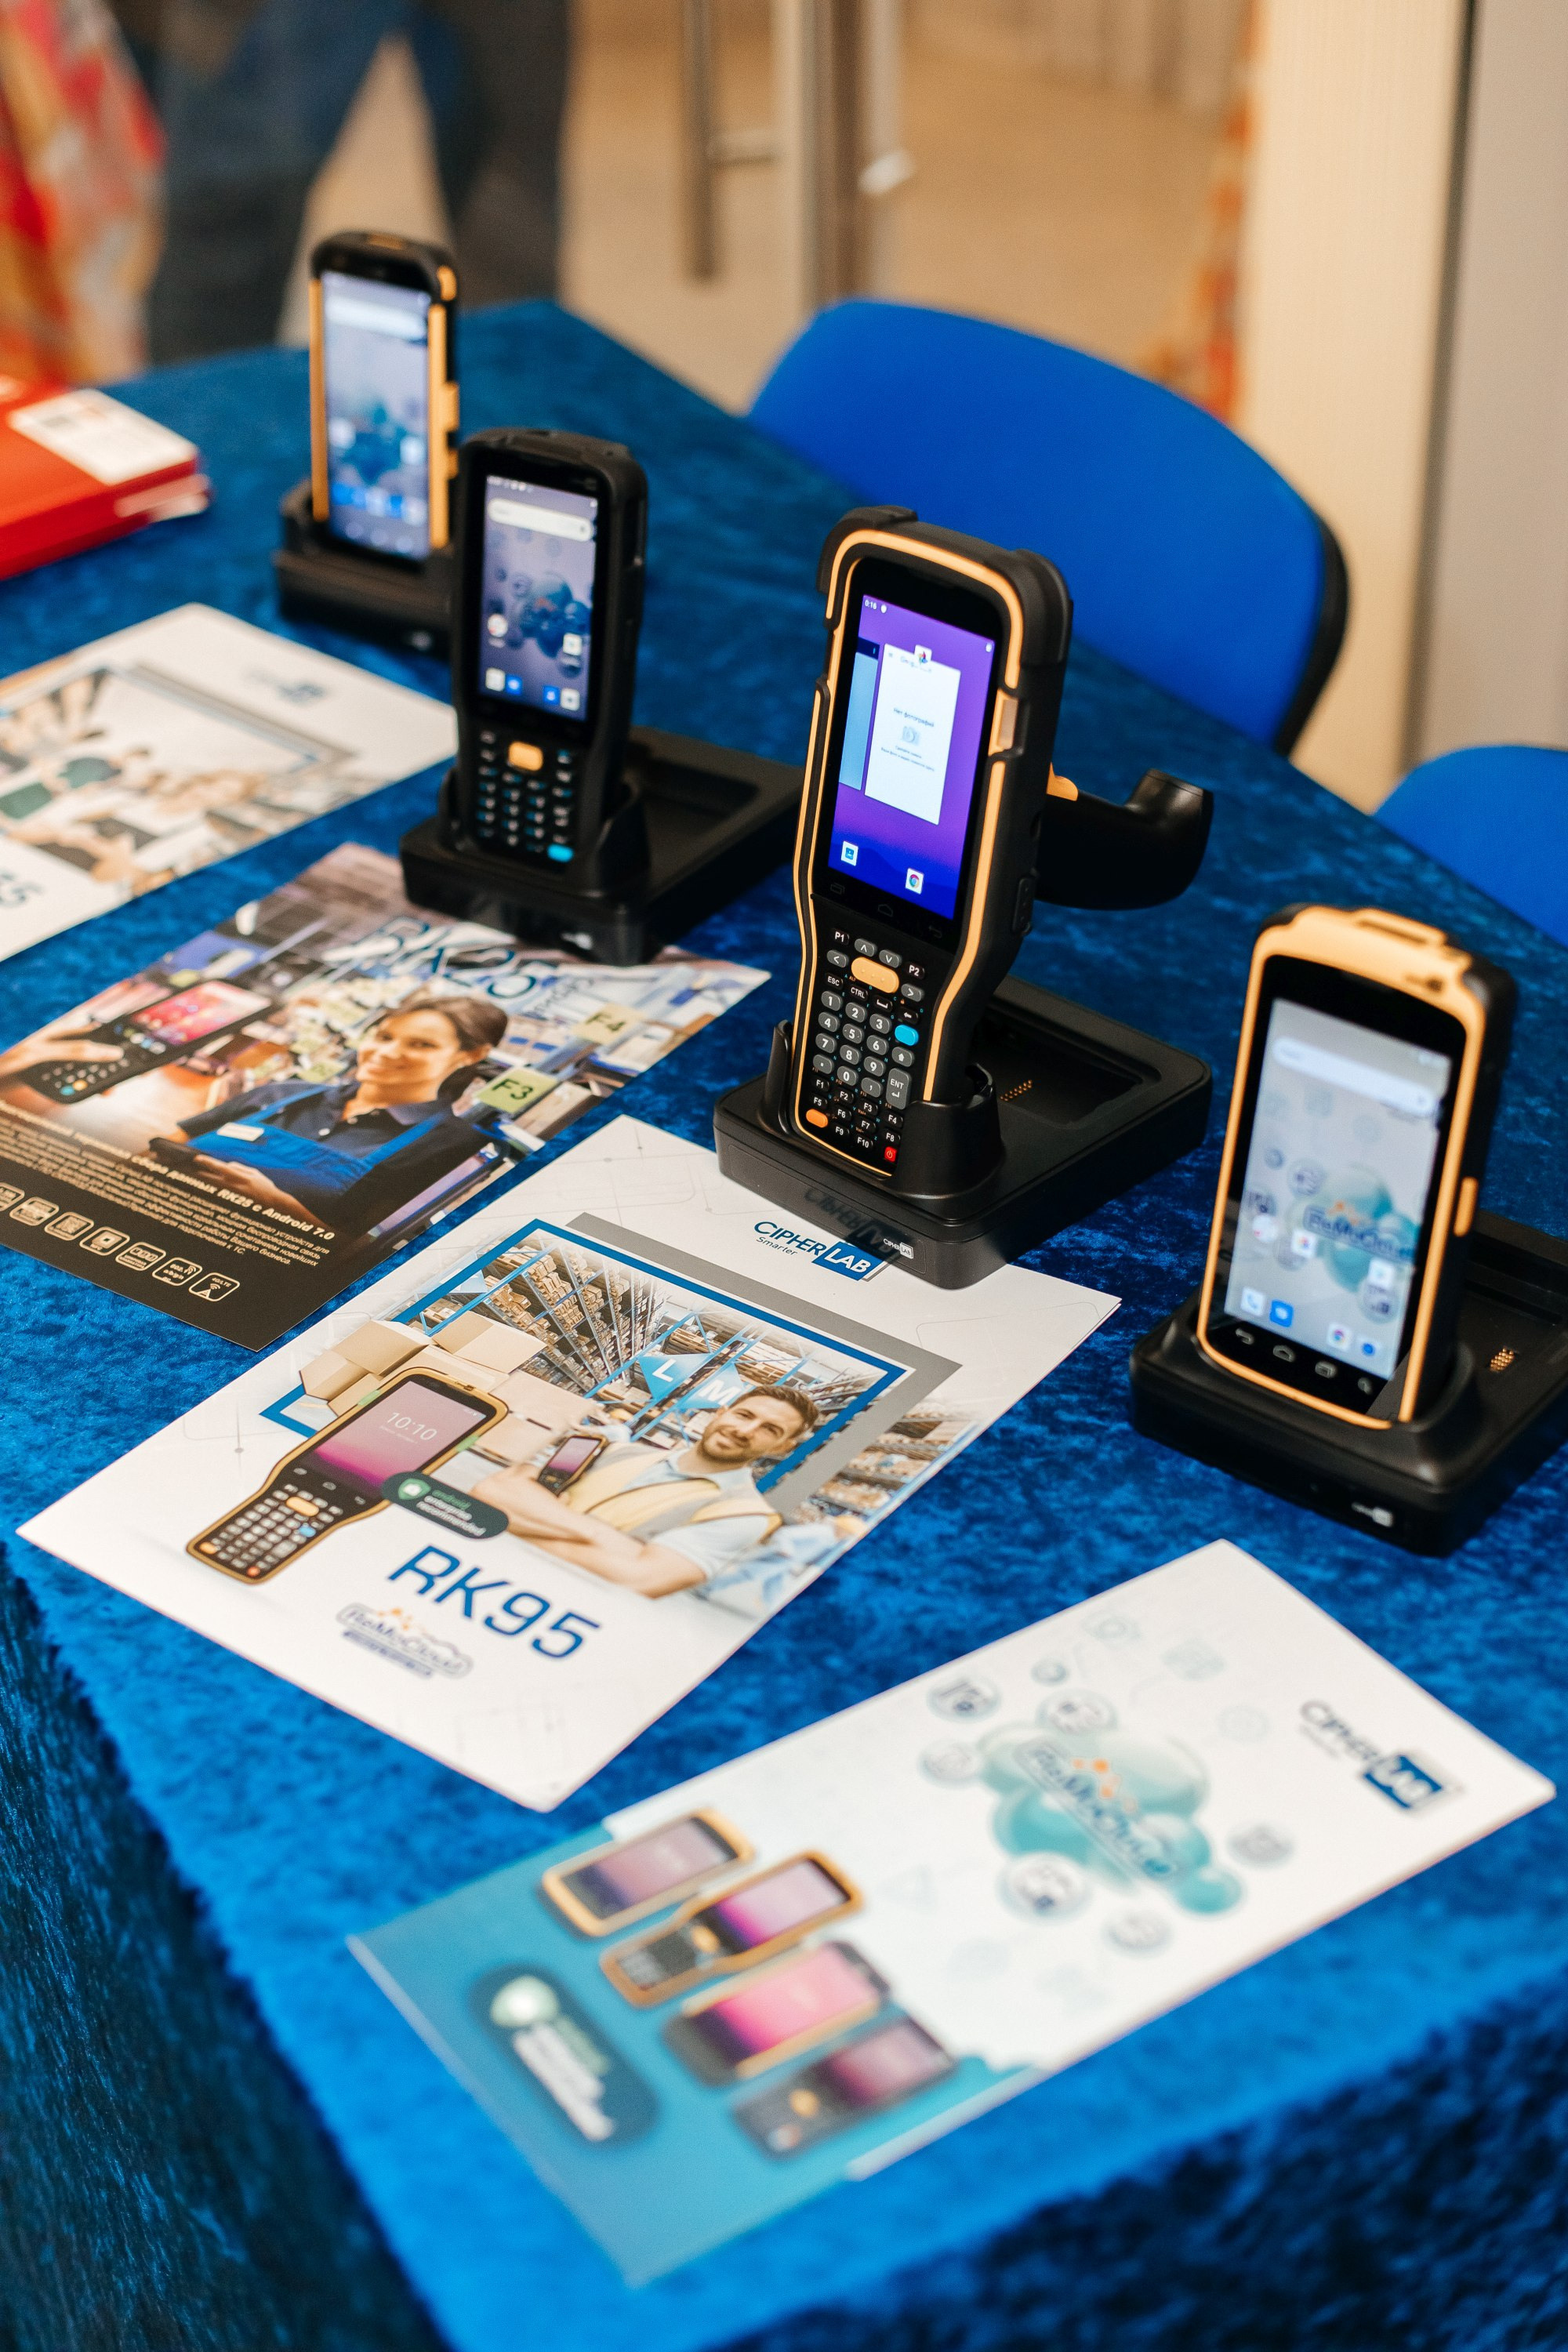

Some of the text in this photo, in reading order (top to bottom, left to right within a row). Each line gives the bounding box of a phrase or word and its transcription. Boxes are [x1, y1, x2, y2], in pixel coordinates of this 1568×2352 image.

[835, 931, 844, 942] P1
[909, 964, 920, 977] P2
[827, 976, 840, 986] ESC
[851, 987, 866, 999] CTRL
[851, 1007, 859, 1018] 2
[824, 1018, 831, 1028] 4
[876, 1018, 883, 1029] 3
[848, 1029, 855, 1040] 5
[822, 1038, 829, 1048] 7
[873, 1040, 880, 1051] 6
[845, 1051, 852, 1061] 8
[869, 1062, 877, 1072] 9
[492, 1077, 534, 1101] F3
[816, 1080, 824, 1088] F1
[890, 1078, 904, 1090] ENT
[840, 1091, 848, 1100] F2
[813, 1097, 822, 1106] F5
[863, 1102, 872, 1112] F3
[837, 1109, 846, 1118] F6
[888, 1114, 897, 1124] F4
[835, 1126, 844, 1135] F9
[861, 1120, 870, 1130] F7
[857, 1136, 869, 1149] F10
[886, 1132, 895, 1142] F8
[217, 1189, 254, 1208] RK25
[262, 1207, 314, 1232] Android
[313, 1227, 335, 1240] 7.0
[756, 1236, 798, 1256] Smarter
[652, 1359, 678, 1382] L
[699, 1379, 742, 1406] M
[387, 1412, 437, 1441] 10:10
[388, 1544, 601, 1659] RK95
